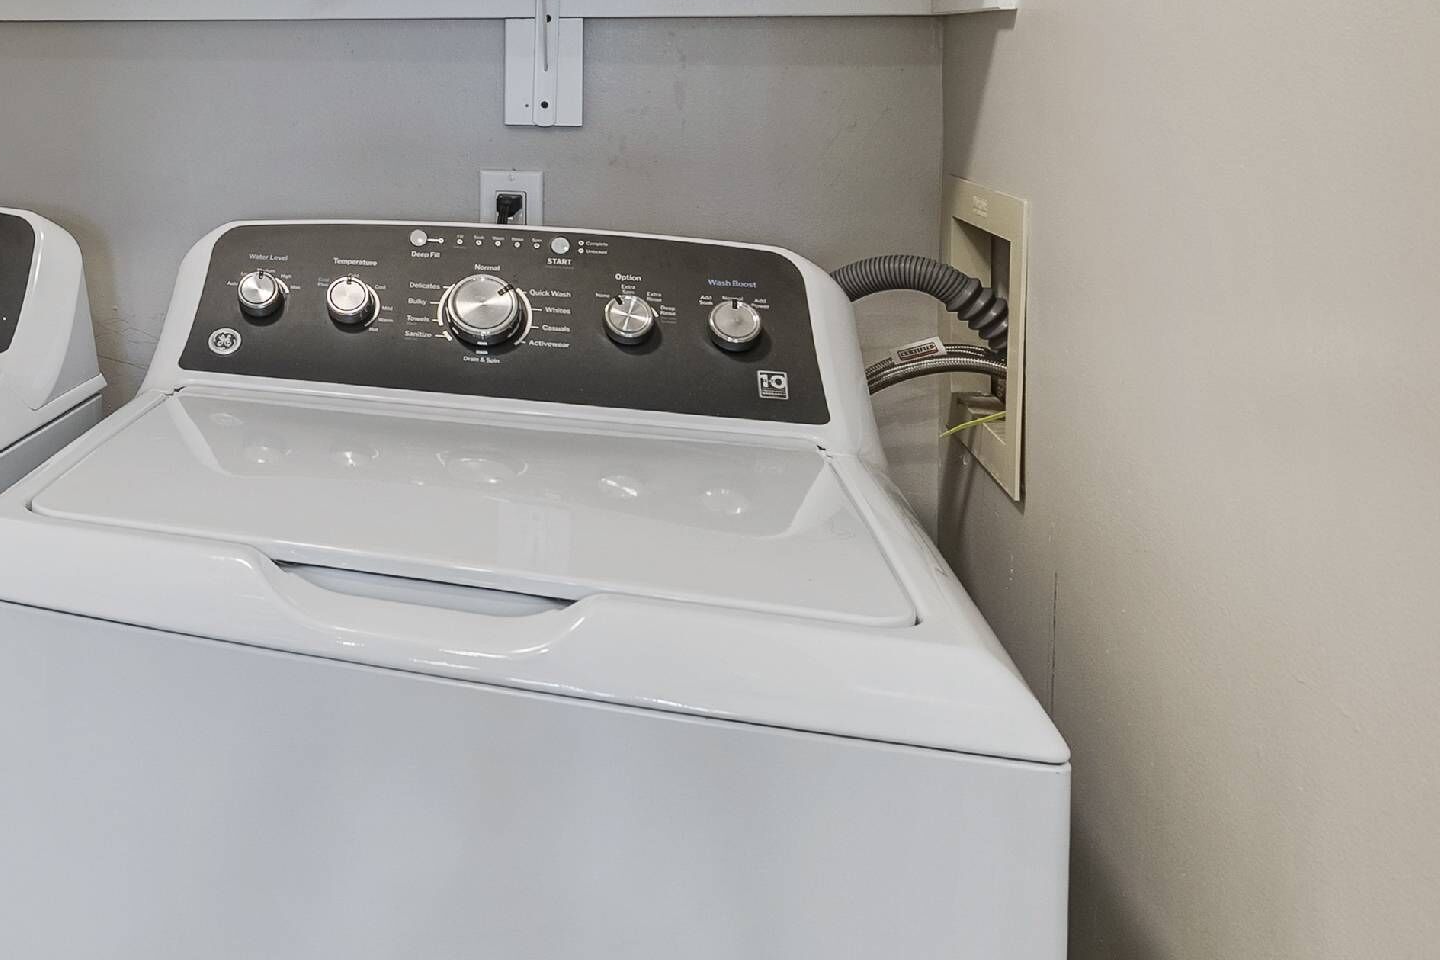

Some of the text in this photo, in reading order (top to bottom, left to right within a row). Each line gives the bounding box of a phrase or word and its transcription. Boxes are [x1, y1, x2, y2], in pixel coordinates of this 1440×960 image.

[411, 250, 429, 258] Deep
[333, 256, 378, 267] Temperature
[474, 263, 501, 271] Normal
[614, 272, 642, 281] Option
[409, 280, 441, 289] Delicates
[707, 279, 757, 288] Wash Boost
[529, 288, 572, 298] Quick Wash
[408, 297, 427, 306] Bulky
[406, 314, 430, 322] Towels
[528, 340, 570, 348] Activewear
